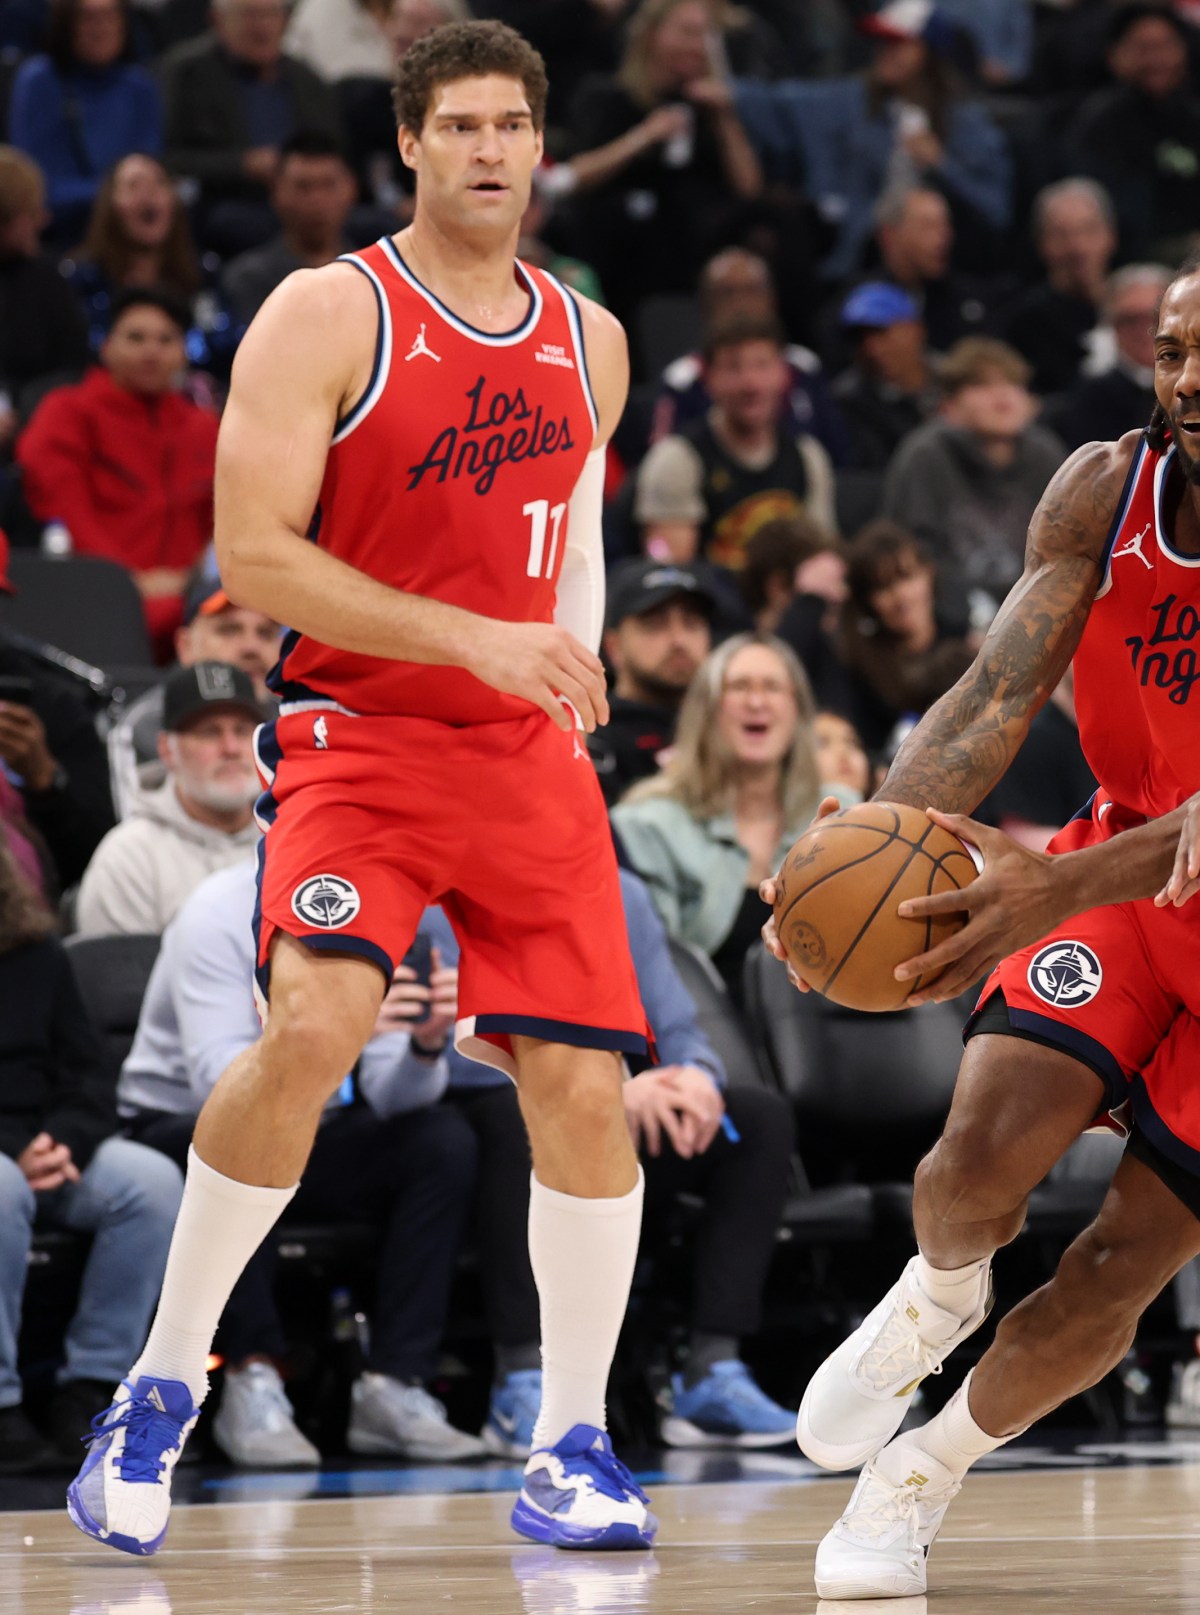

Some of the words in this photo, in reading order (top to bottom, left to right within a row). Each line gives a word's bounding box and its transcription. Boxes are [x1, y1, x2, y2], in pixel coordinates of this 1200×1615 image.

[465, 375, 532, 433] Los
[406, 405, 574, 496] Angeles
[523, 499, 567, 579] 11
